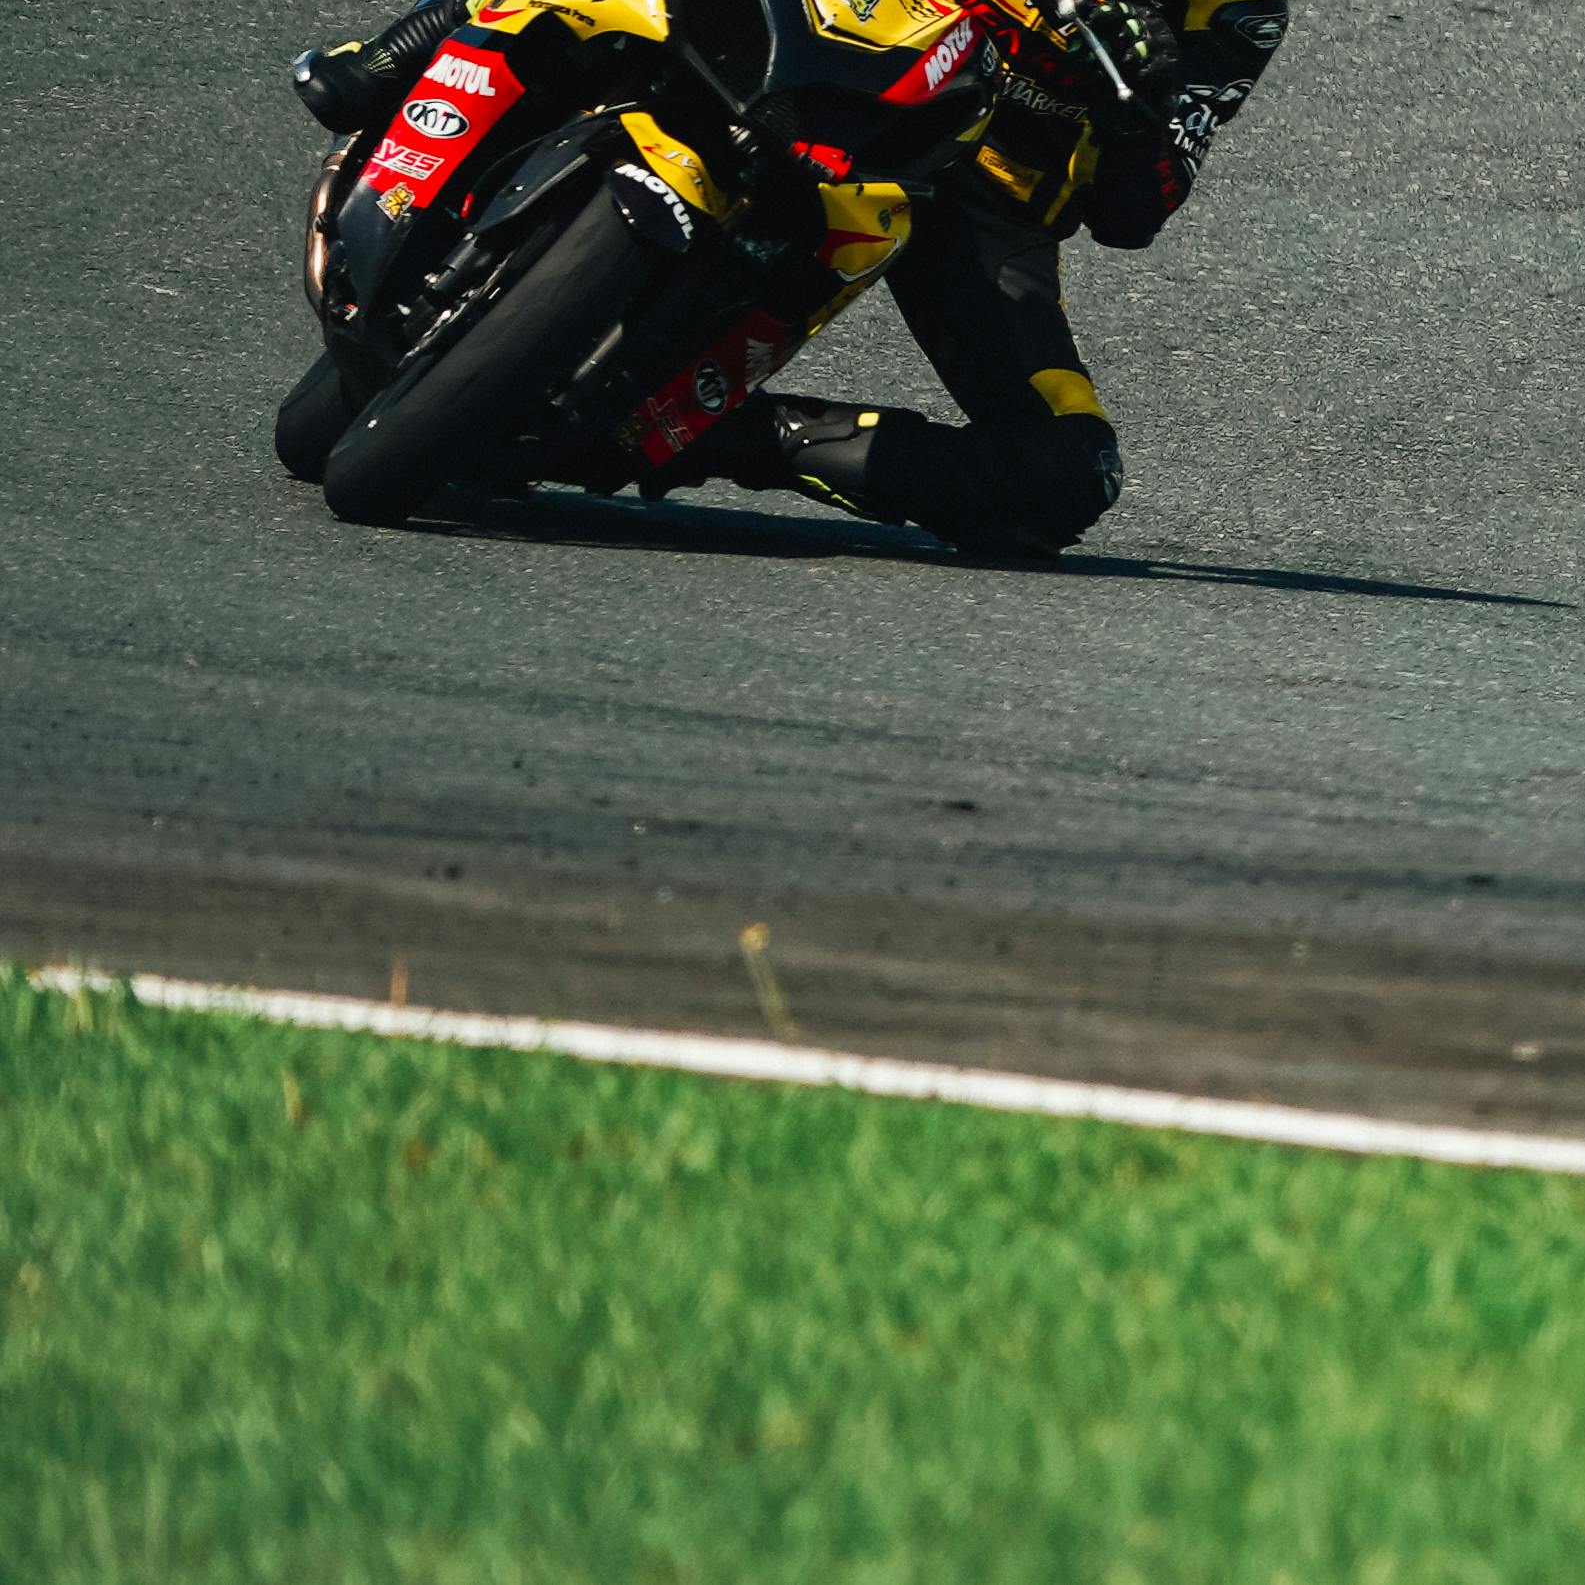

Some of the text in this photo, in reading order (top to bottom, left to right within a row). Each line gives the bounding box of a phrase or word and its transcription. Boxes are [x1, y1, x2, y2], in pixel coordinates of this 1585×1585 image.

[424, 53, 496, 97] MOTUL
[923, 16, 975, 91] MOTUL
[374, 139, 444, 171] YSS
[614, 162, 695, 240] MOTUL
